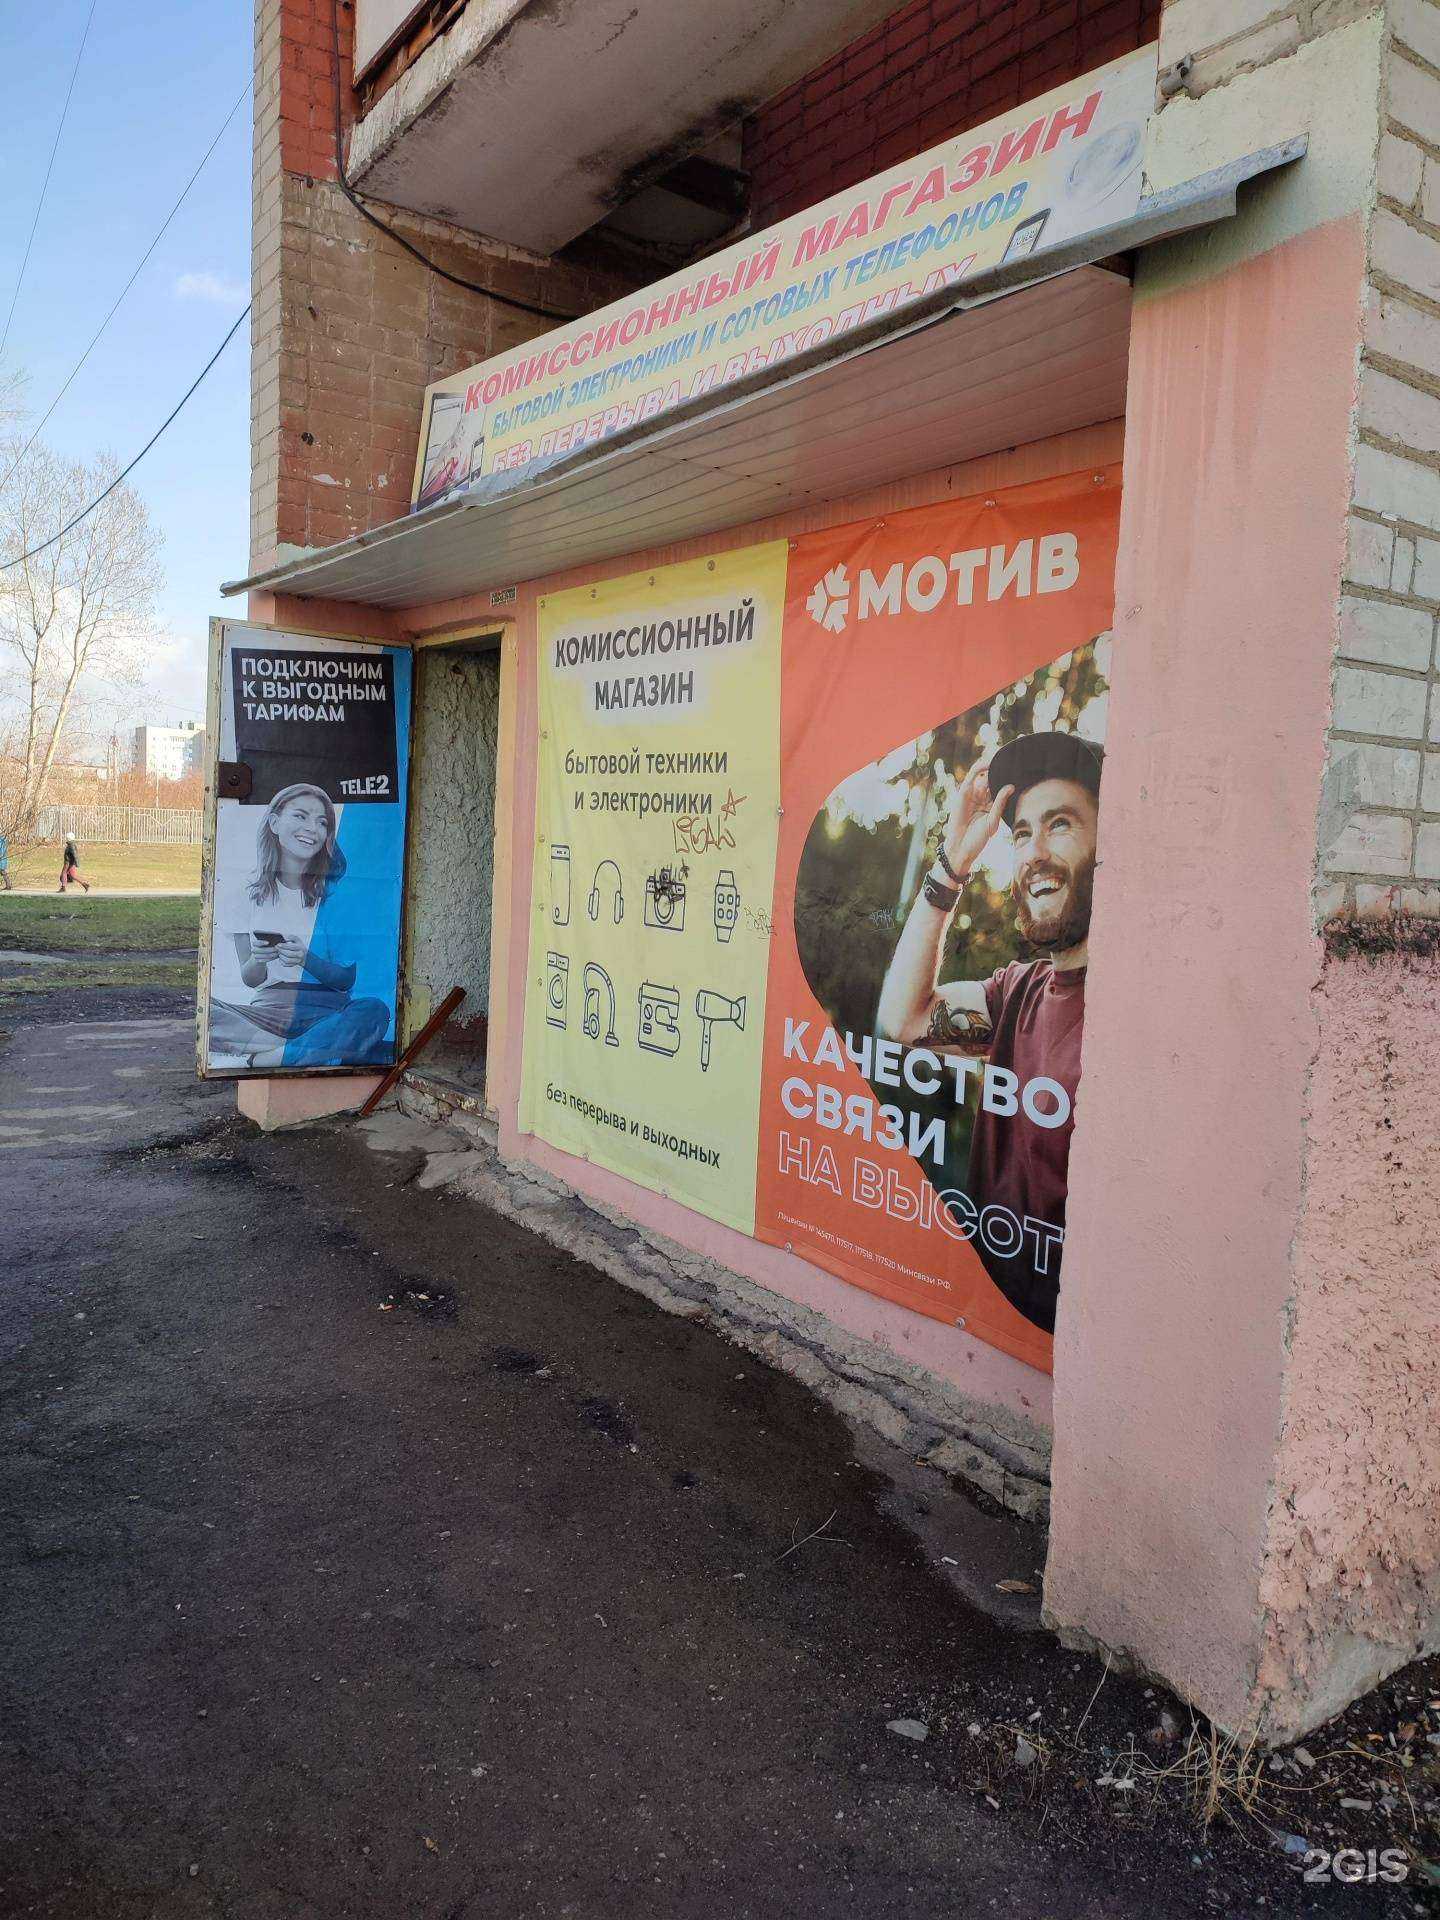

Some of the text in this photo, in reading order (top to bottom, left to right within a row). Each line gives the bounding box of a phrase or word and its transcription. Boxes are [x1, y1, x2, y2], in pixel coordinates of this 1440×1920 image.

[464, 90, 1103, 414] КОМИССИОННЫЙ МАГАЗИН
[491, 181, 1029, 438] БЫТОВОЙ ЭЛЕКТРОНИКИ И СОТОВЫХ ТЕЛЕФОНОВ
[492, 439, 532, 473] БЕЗ
[537, 379, 681, 458] ПЕРЕРЫВА
[689, 363, 718, 400] И
[857, 531, 1080, 620] МОТИВ
[555, 597, 755, 668] КОМИССИОННЫЙ
[241, 657, 383, 681] ПОДКЛЮЧИМ
[242, 680, 387, 703] К ВЫГОДНЫМ
[595, 670, 694, 710] МАГАЗИН
[242, 702, 345, 722] ТАРИФАМ
[339, 774, 390, 796] TELE2
[564, 746, 728, 775] бытовой техники
[573, 789, 713, 819] и электроники
[783, 1017, 1071, 1129] КАЧЕСТВО
[546, 1082, 722, 1170] без перерыва и выходных
[780, 1076, 946, 1166] СВЯЗИ
[778, 1131, 1065, 1275] НА ВЫСОТ
[897, 1263, 936, 1286] Минсвязи
